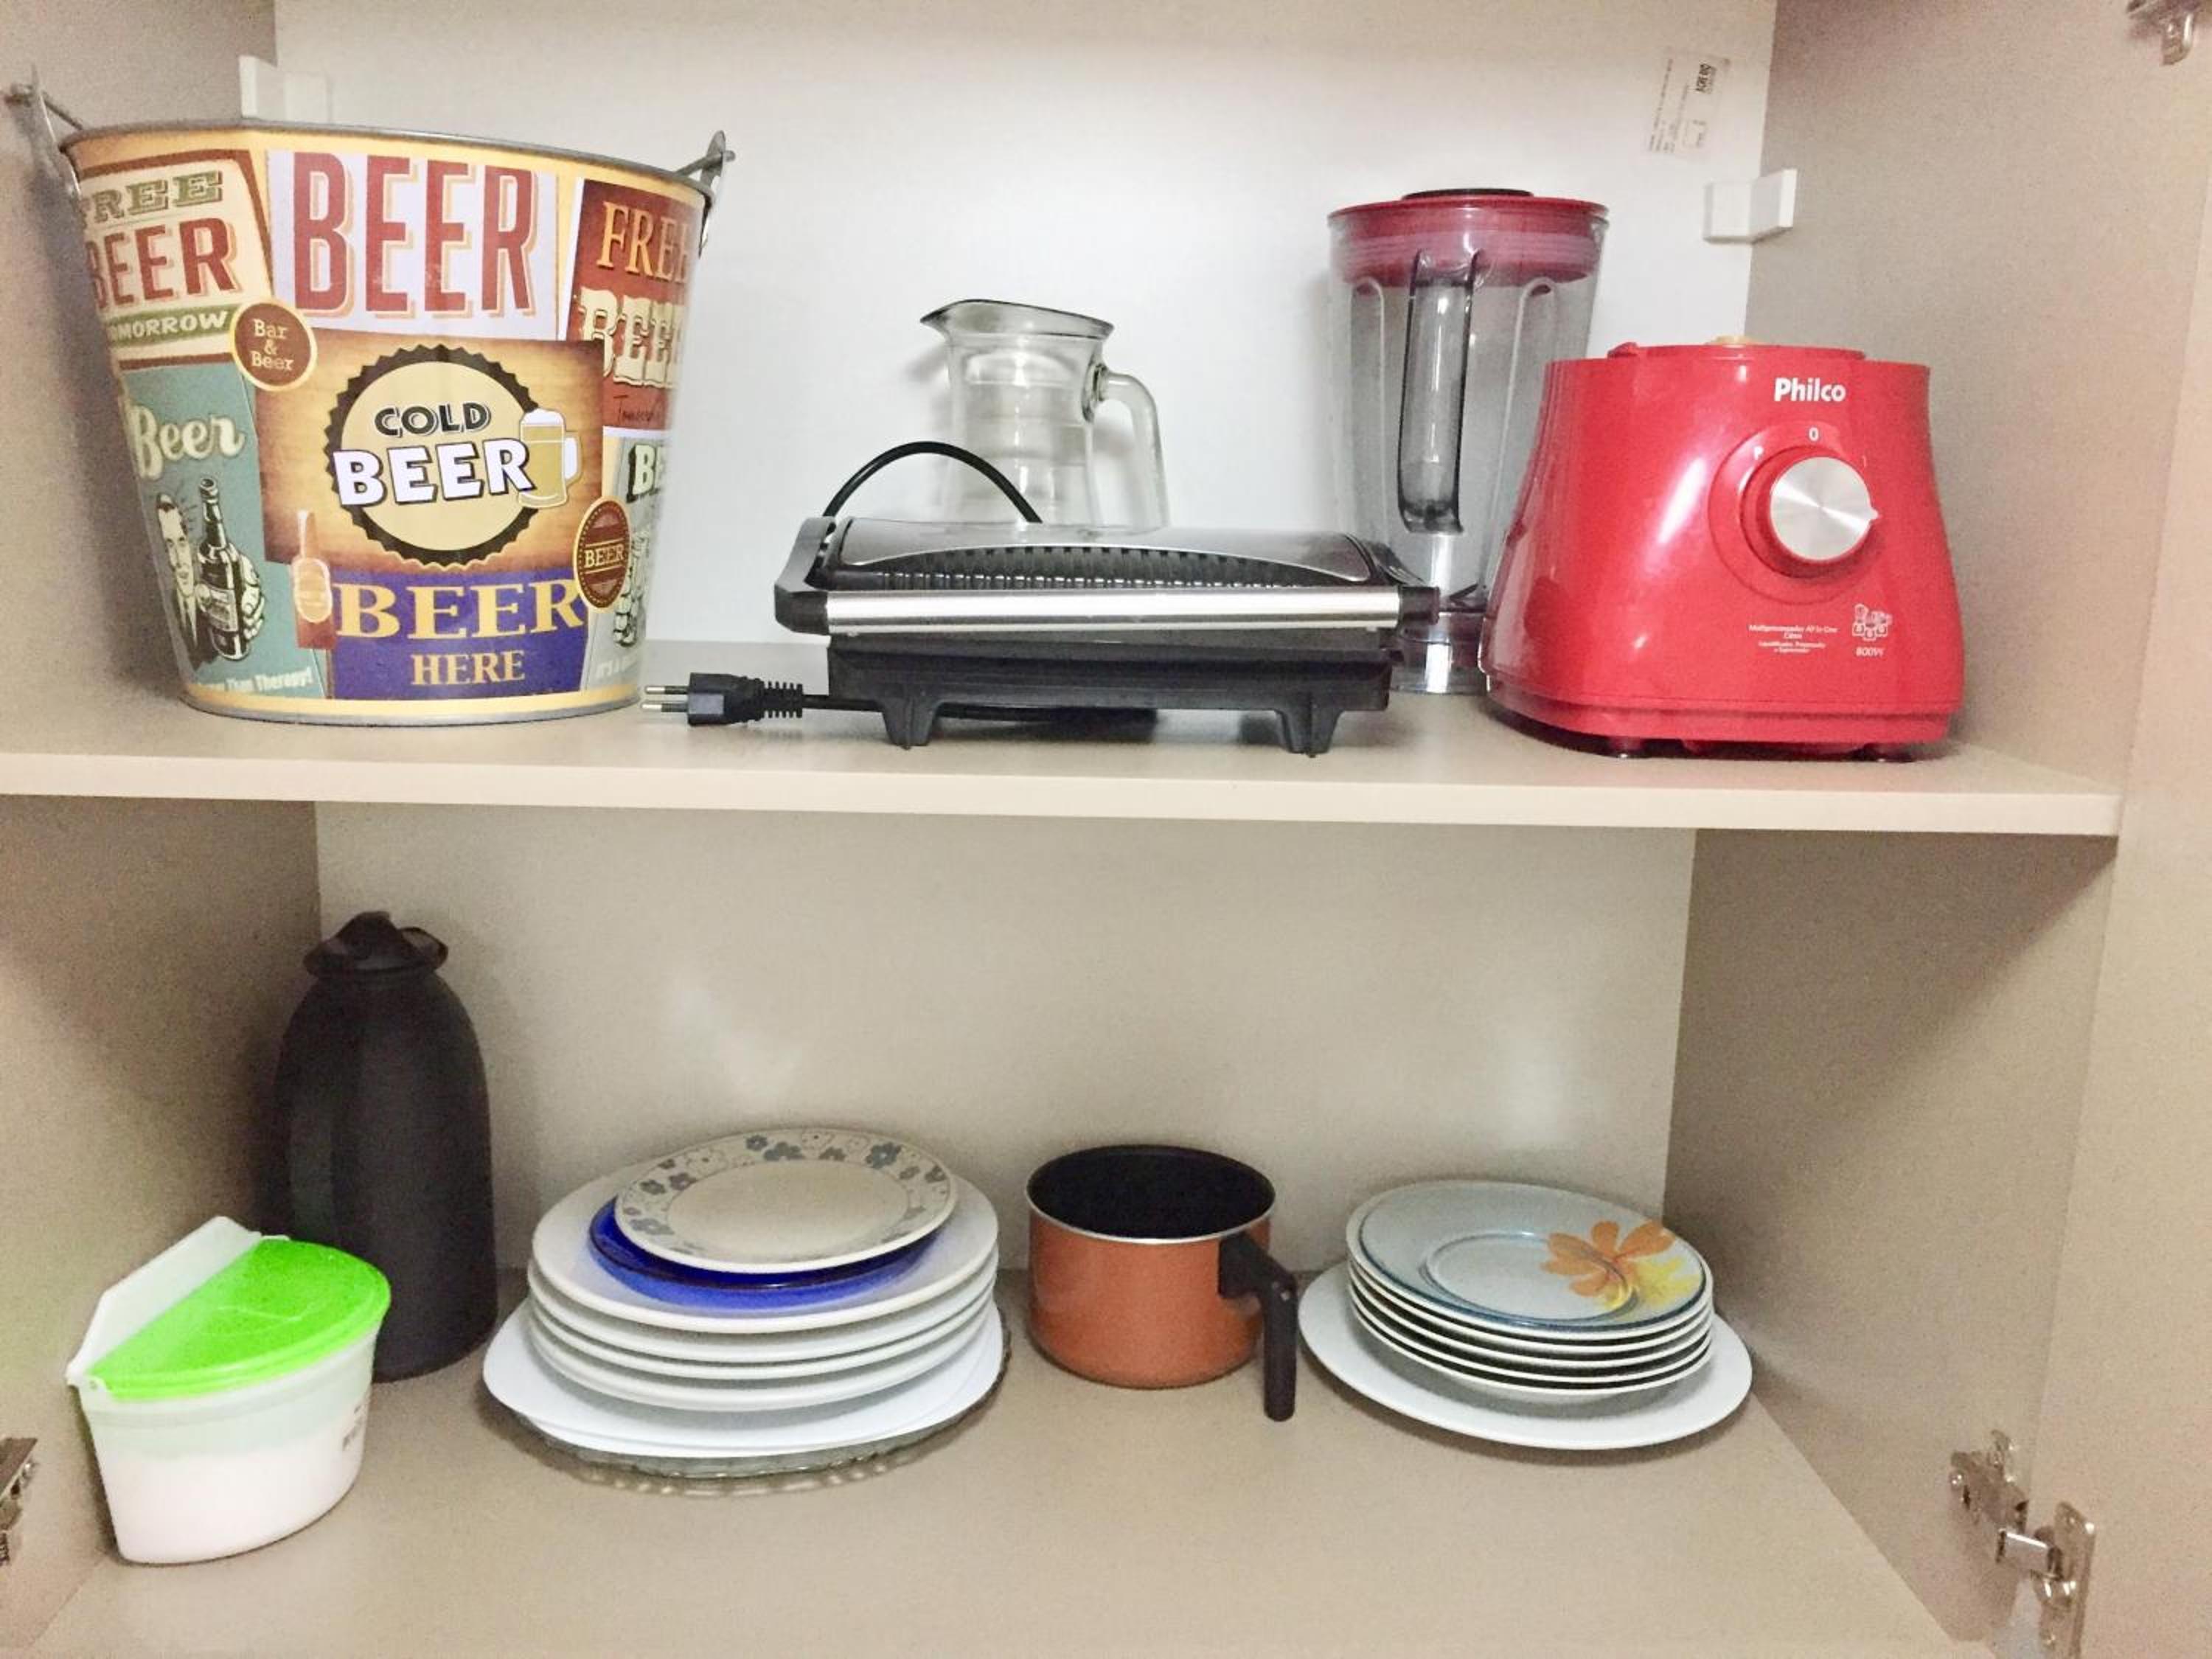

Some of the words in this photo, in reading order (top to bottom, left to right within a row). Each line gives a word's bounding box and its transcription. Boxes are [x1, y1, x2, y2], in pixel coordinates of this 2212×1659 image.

[293, 152, 536, 317] BEER
[253, 318, 288, 339] Bar
[251, 351, 293, 371] Beer
[1774, 377, 1846, 401] Philco
[374, 402, 492, 438] COLD
[127, 405, 245, 481] Beer
[333, 437, 537, 507] BEER
[584, 544, 625, 568] BEER
[333, 580, 584, 640] BEER
[411, 650, 525, 686] HERE
